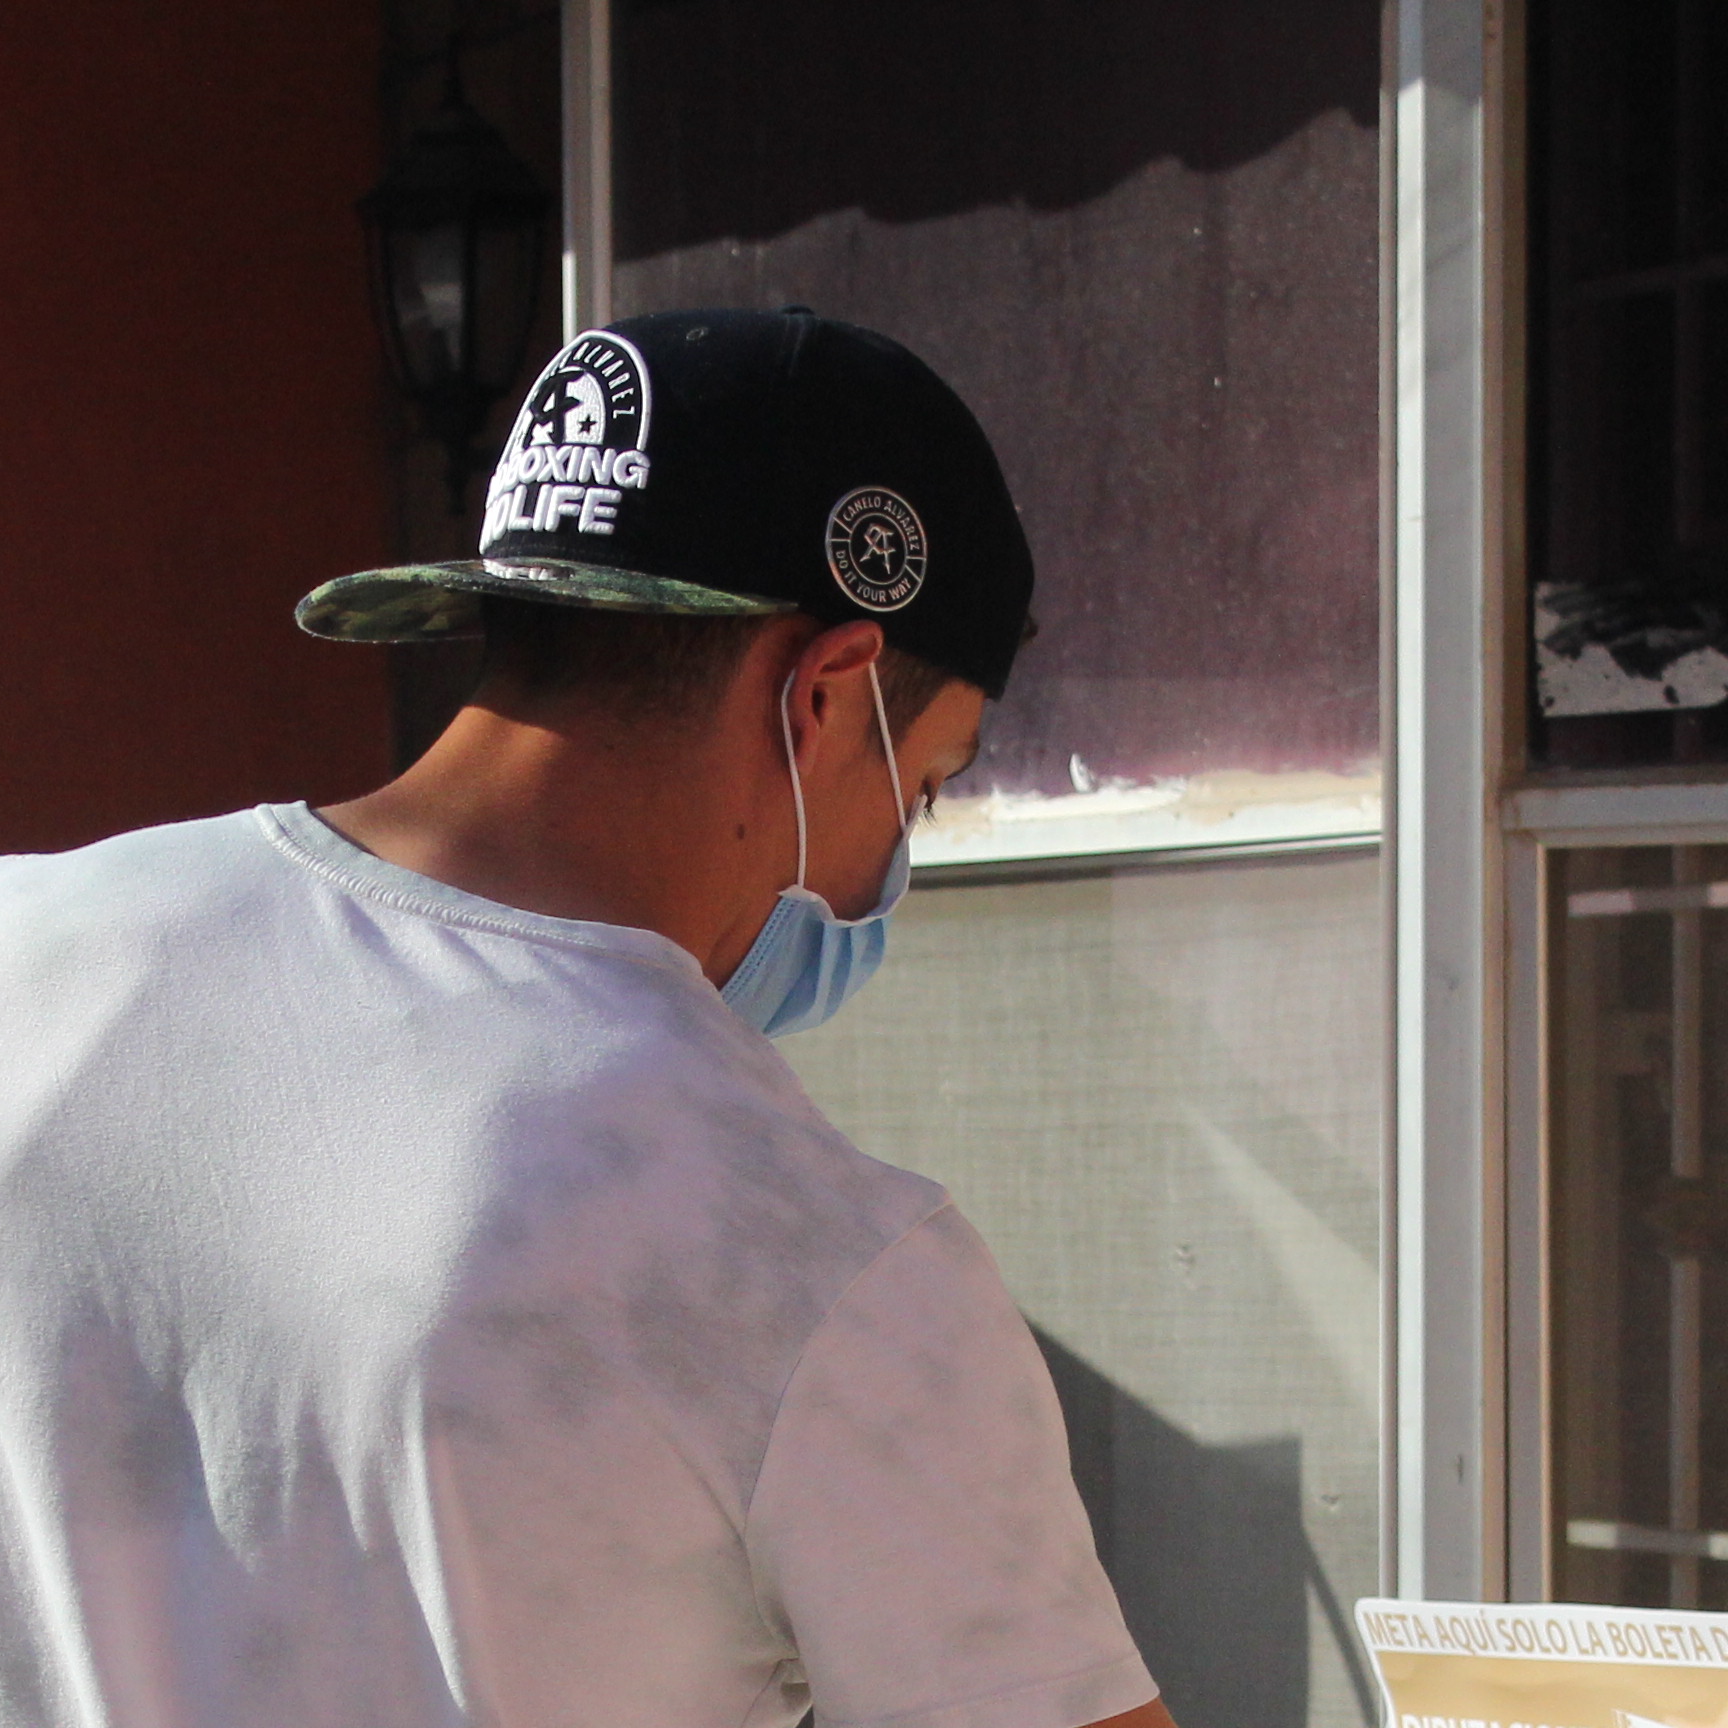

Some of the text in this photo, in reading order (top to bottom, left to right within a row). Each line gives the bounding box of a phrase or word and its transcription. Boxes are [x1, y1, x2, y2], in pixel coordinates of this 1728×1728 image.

[573, 342, 635, 419] ALVAREZ
[504, 446, 651, 490] BOXING
[508, 483, 622, 535] LIFE
[842, 496, 920, 551] CANELO ALVAREZ
[835, 550, 912, 602] DO IT YOUR WAY
[1363, 1612, 1430, 1649] META
[1433, 1609, 1495, 1656] AQUÍ
[1496, 1618, 1569, 1655] SOLO
[1570, 1619, 1608, 1657] LA
[1607, 1620, 1713, 1663] BOLETA
